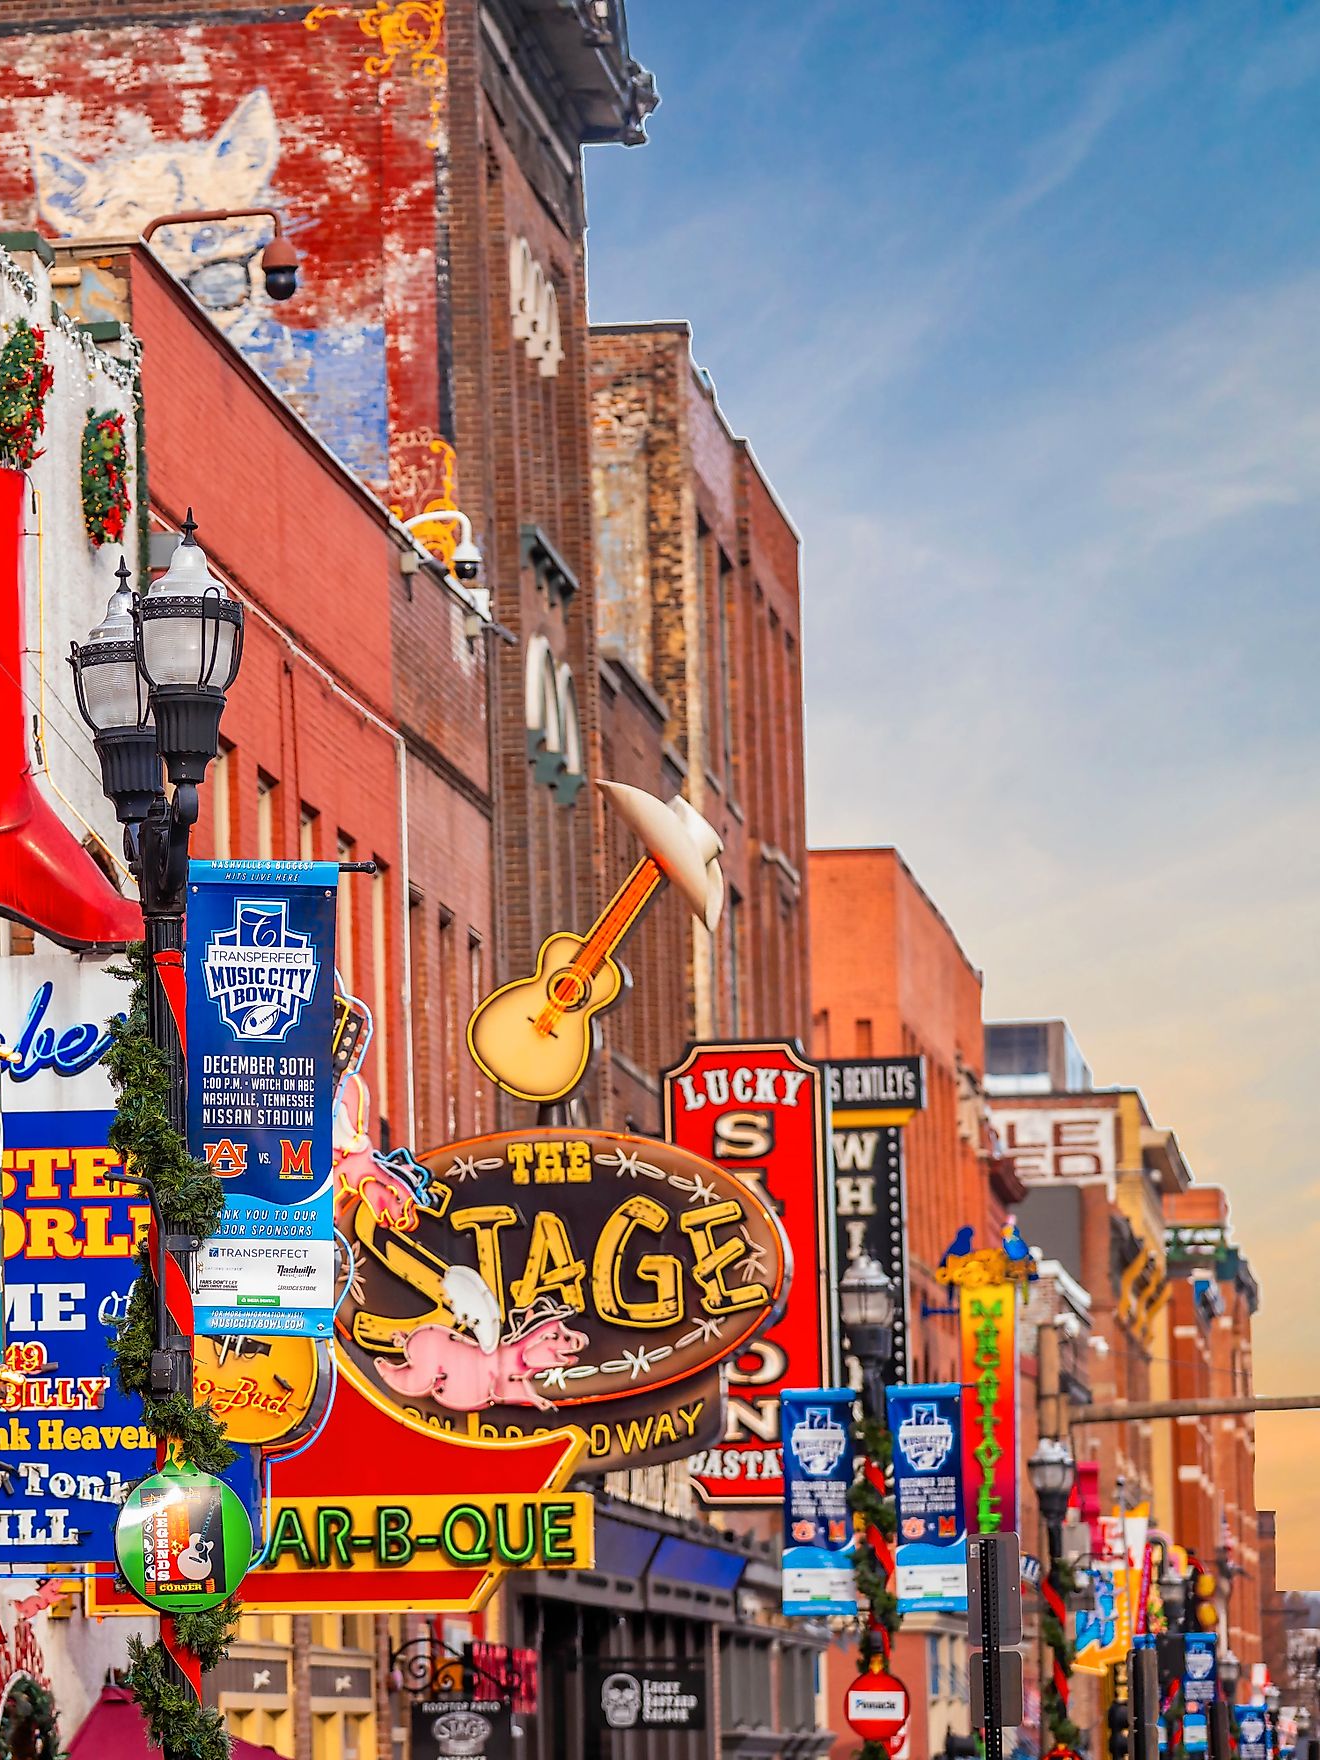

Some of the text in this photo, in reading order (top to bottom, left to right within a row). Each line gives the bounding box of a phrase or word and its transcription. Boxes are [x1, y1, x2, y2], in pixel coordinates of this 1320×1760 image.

[275, 862, 315, 871] BIGGEST
[224, 872, 300, 882] HITS LIVE HERE
[211, 950, 310, 965] TRANSPERFECT
[209, 966, 311, 993] MUSIC CITY
[233, 986, 287, 1008] BOWL
[203, 1055, 314, 1077] DECEMBER 30TH
[202, 1077, 315, 1091] 1:00 P.M. WATCH ON ABC
[677, 1067, 808, 1111] LUCKY
[202, 1092, 315, 1108] NASHVILLE, TENNESSEE
[202, 1108, 314, 1126] NISSAN STADIUM
[258, 1153, 271, 1164] VS.
[507, 1140, 592, 1186] THE
[217, 1210, 317, 1221] ANK YOU TO OUR
[215, 1225, 312, 1236] AJOR SPONSORS
[220, 1248, 308, 1259] TRANSPERFECT
[352, 1194, 770, 1354] STAGE
[5, 1283, 86, 1332] ME
[210, 1319, 305, 1330] MUSICCITYBOWL.COM
[0, 1376, 111, 1412] BILLY
[193, 1375, 294, 1416] o-Bud
[687, 1448, 784, 1481] BASTA
[19, 1462, 129, 1505] Tonk
[252, 1502, 576, 1566] AR-B-QUE
[159, 1582, 202, 1592] CORNER
